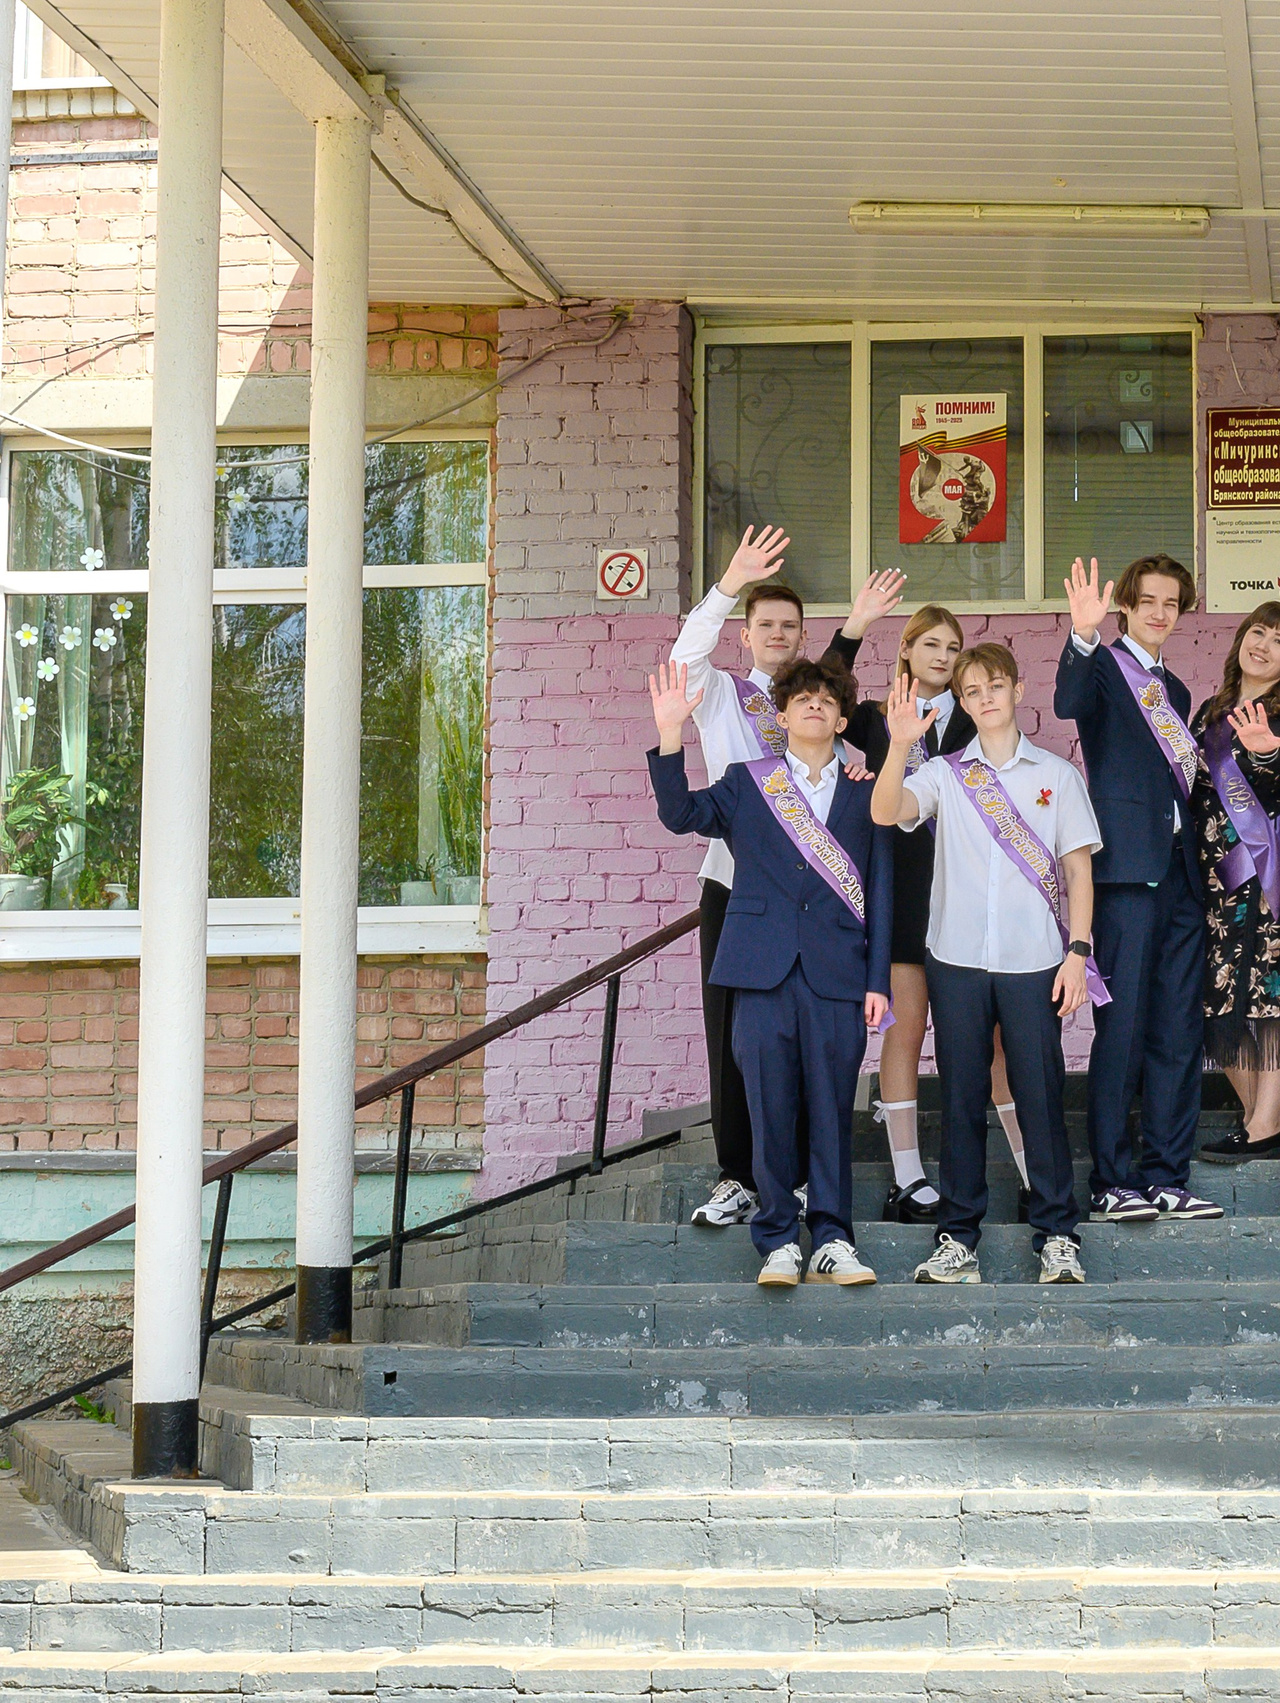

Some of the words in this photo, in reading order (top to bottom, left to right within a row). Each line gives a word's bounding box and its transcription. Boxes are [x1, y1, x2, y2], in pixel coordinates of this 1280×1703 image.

[935, 401, 995, 415] ПОМНИМ!
[944, 485, 962, 494] МАЯ
[1214, 489, 1253, 503] Брянского
[1230, 580, 1274, 590] ТОЧКА
[1225, 776, 1256, 813] 2025
[774, 793, 849, 883] Выпускник
[975, 785, 1051, 880] Выпускник
